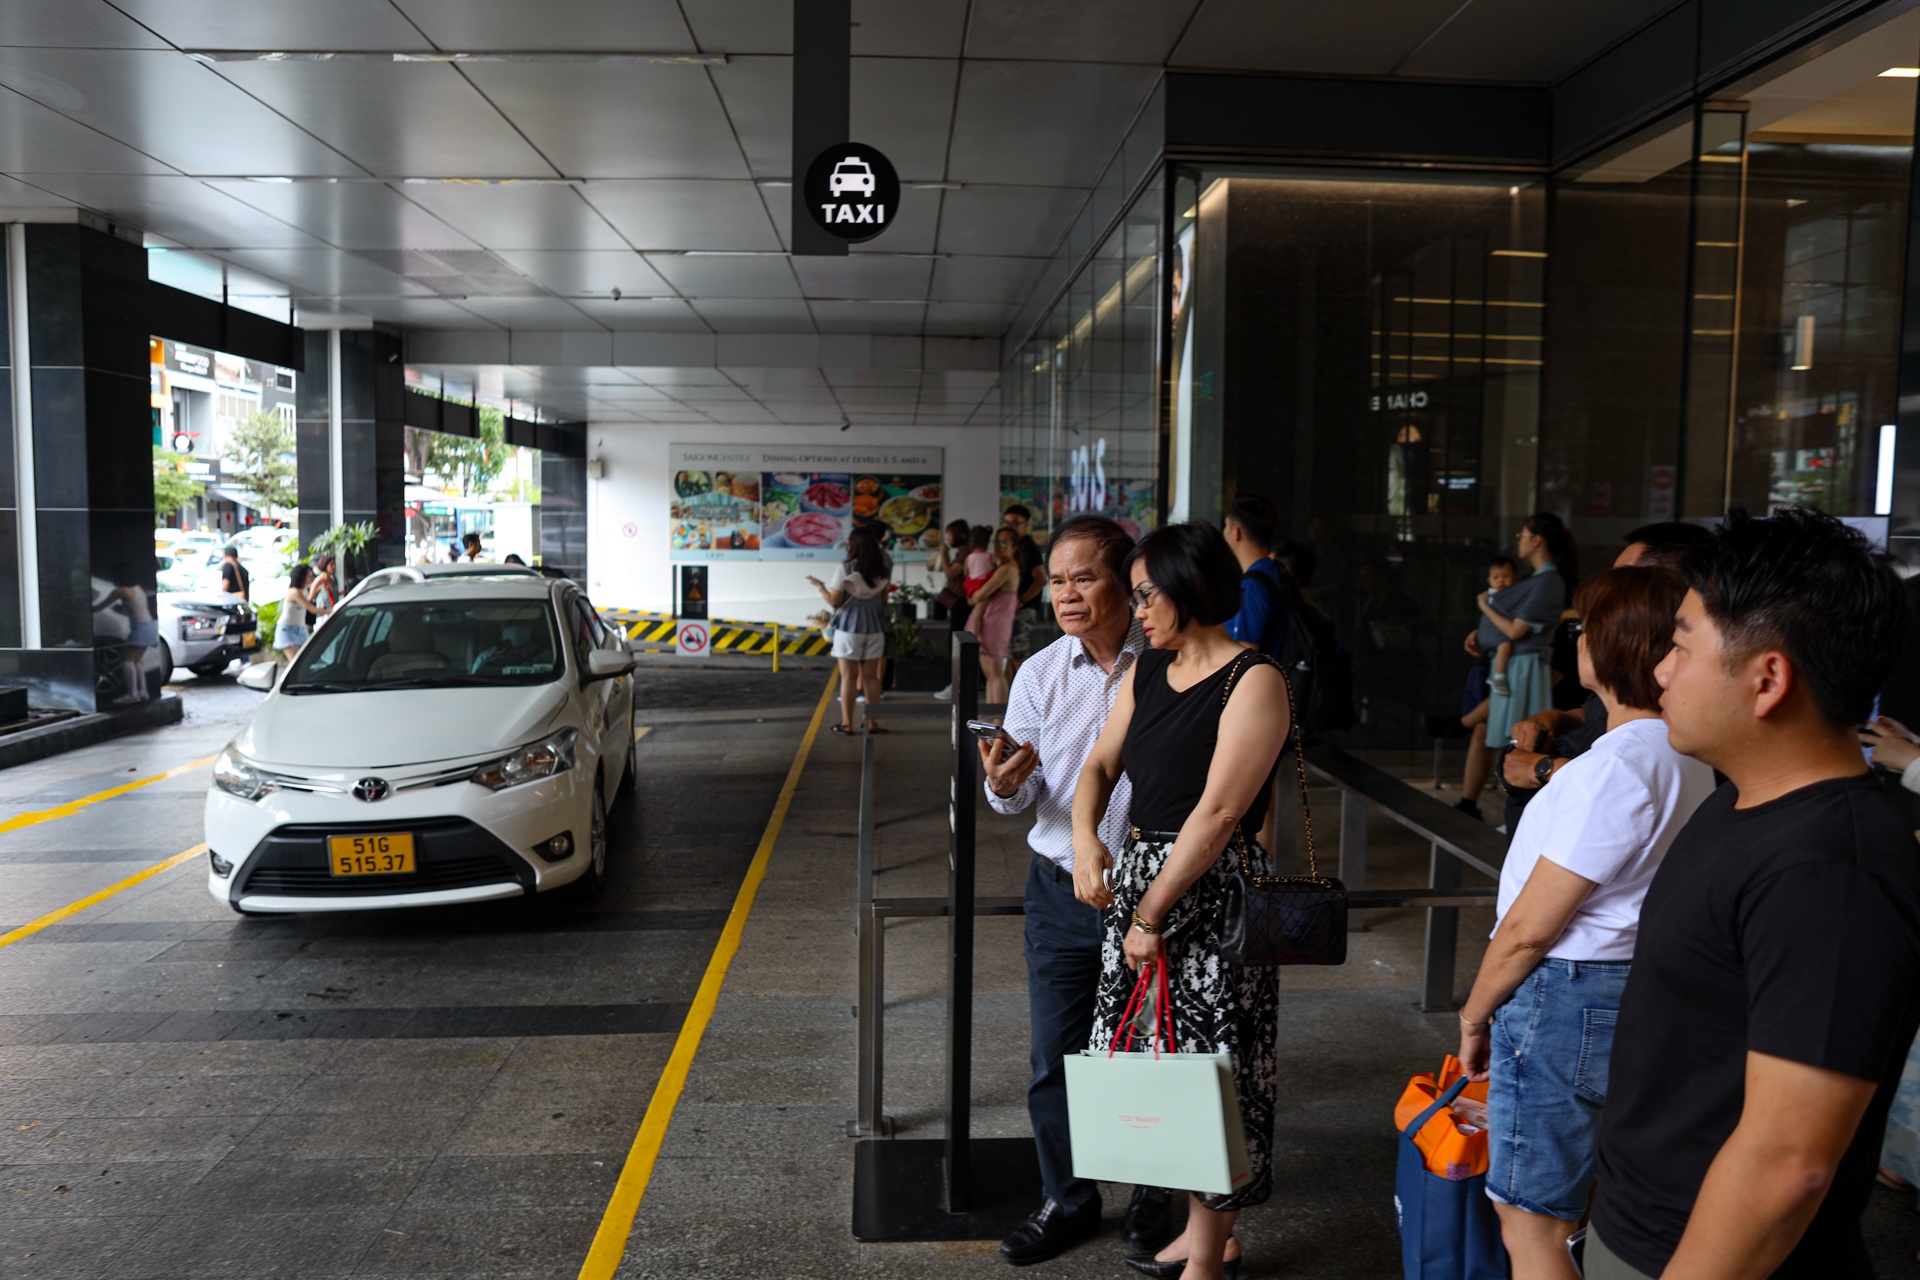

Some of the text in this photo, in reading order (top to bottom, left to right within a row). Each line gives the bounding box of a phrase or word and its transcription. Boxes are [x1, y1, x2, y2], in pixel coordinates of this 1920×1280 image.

[821, 203, 884, 223] TAXI
[353, 836, 389, 854] 51G
[340, 854, 405, 873] 515.37
